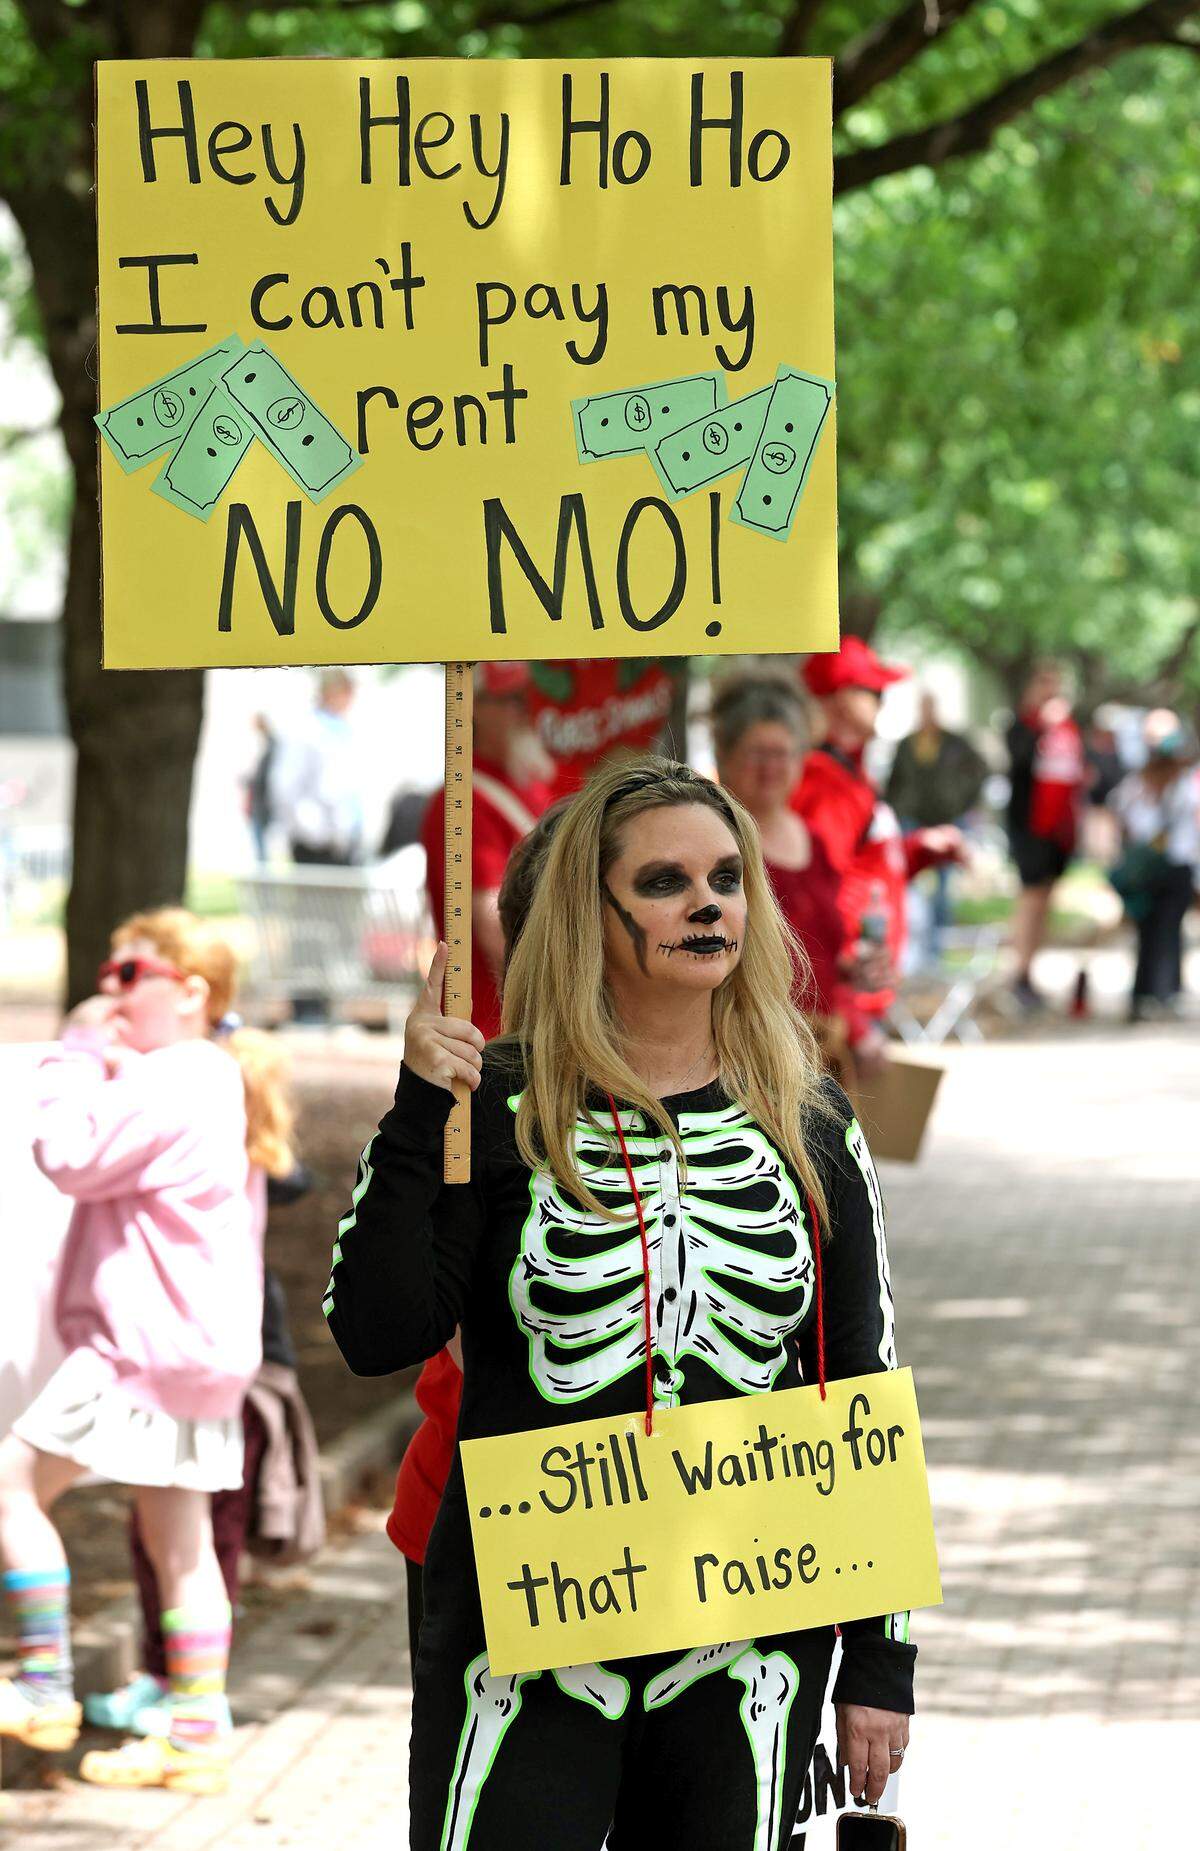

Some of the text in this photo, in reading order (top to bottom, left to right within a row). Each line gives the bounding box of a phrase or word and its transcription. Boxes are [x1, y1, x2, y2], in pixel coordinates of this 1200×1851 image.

[135, 71, 790, 230] Hey Hey Ho Ho
[116, 242, 756, 371] I can't pay my
[356, 364, 528, 455] rent
[218, 491, 722, 637] NO MO!
[455, 691, 463, 701] 18
[455, 718, 463, 728] 17
[455, 745, 463, 755] 16
[454, 772, 463, 782] 15
[454, 799, 462, 809] 14
[454, 826, 462, 836] 13
[454, 853, 462, 863] 12
[841, 1393, 905, 1471] for
[506, 1546, 648, 1627] that
